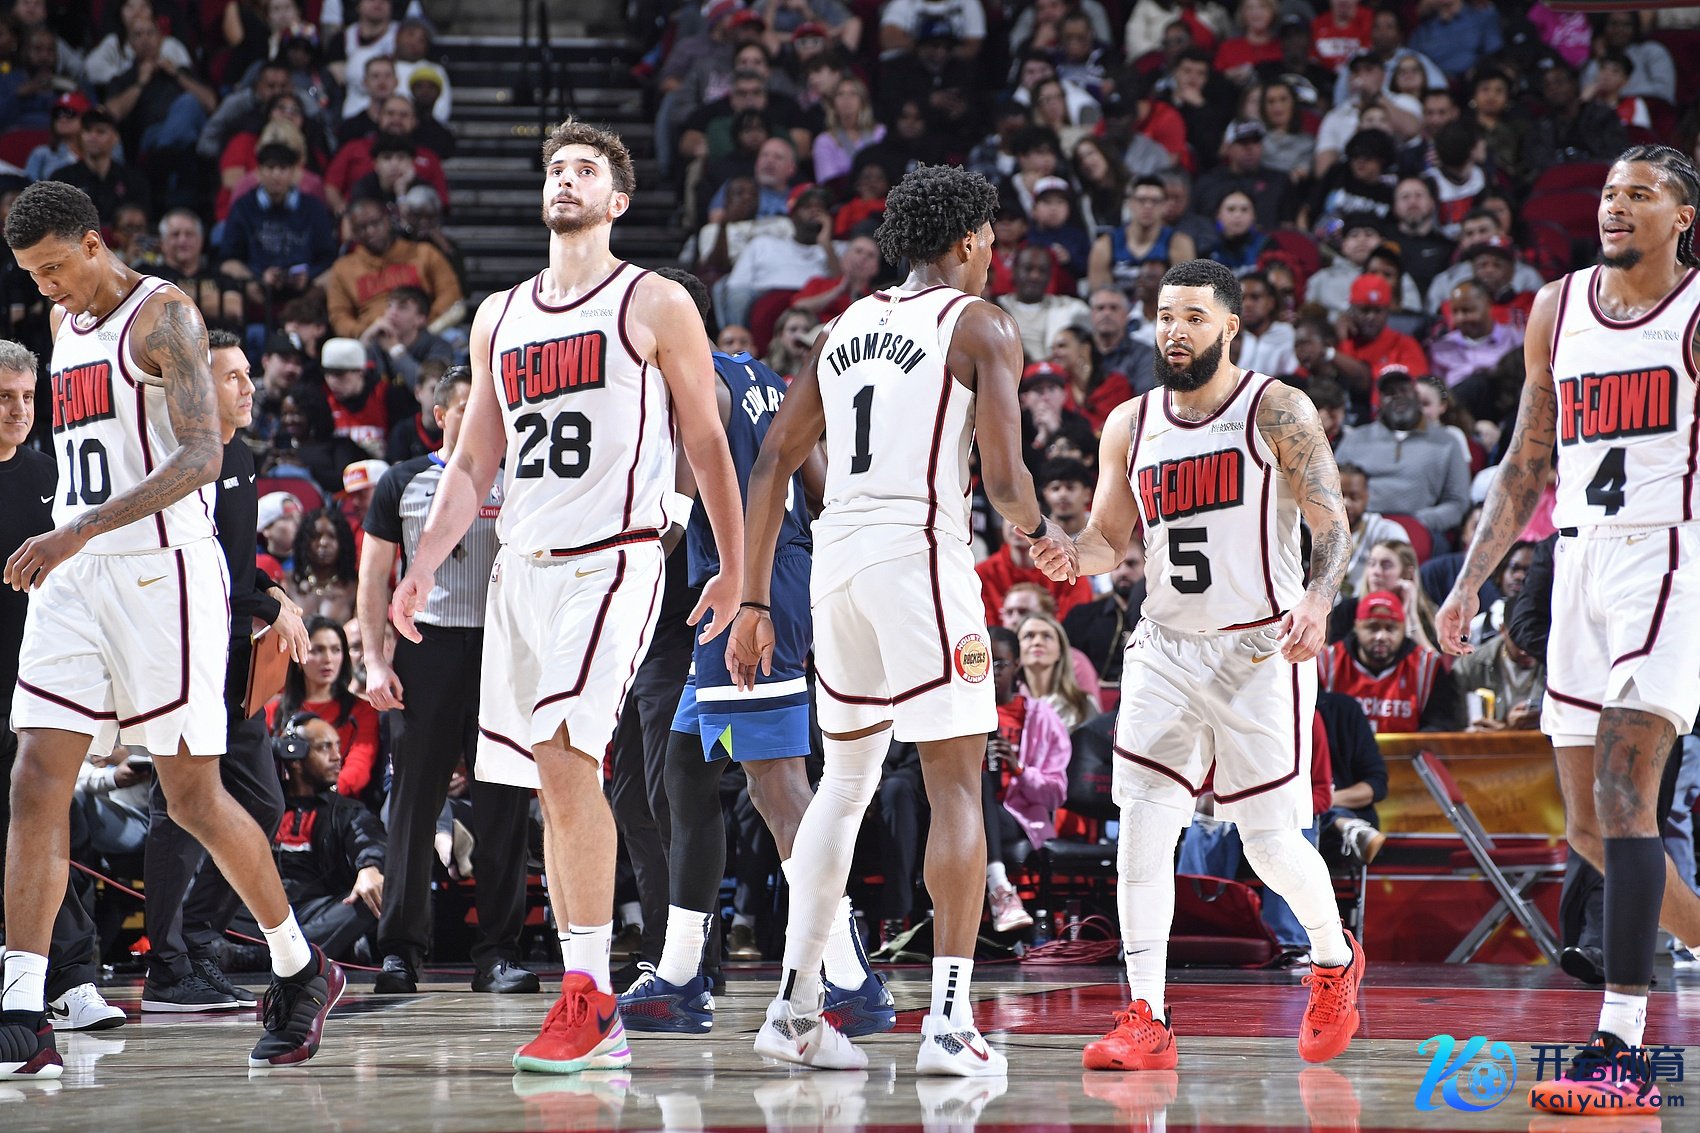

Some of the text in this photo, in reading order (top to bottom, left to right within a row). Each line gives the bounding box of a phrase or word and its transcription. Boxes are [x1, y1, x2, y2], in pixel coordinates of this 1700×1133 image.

[826, 332, 926, 377] THOMPSON
[514, 411, 591, 479] 28
[850, 385, 875, 475] 1
[66, 438, 112, 506] 10
[1585, 447, 1628, 516] 4
[1168, 526, 1212, 594] 5
